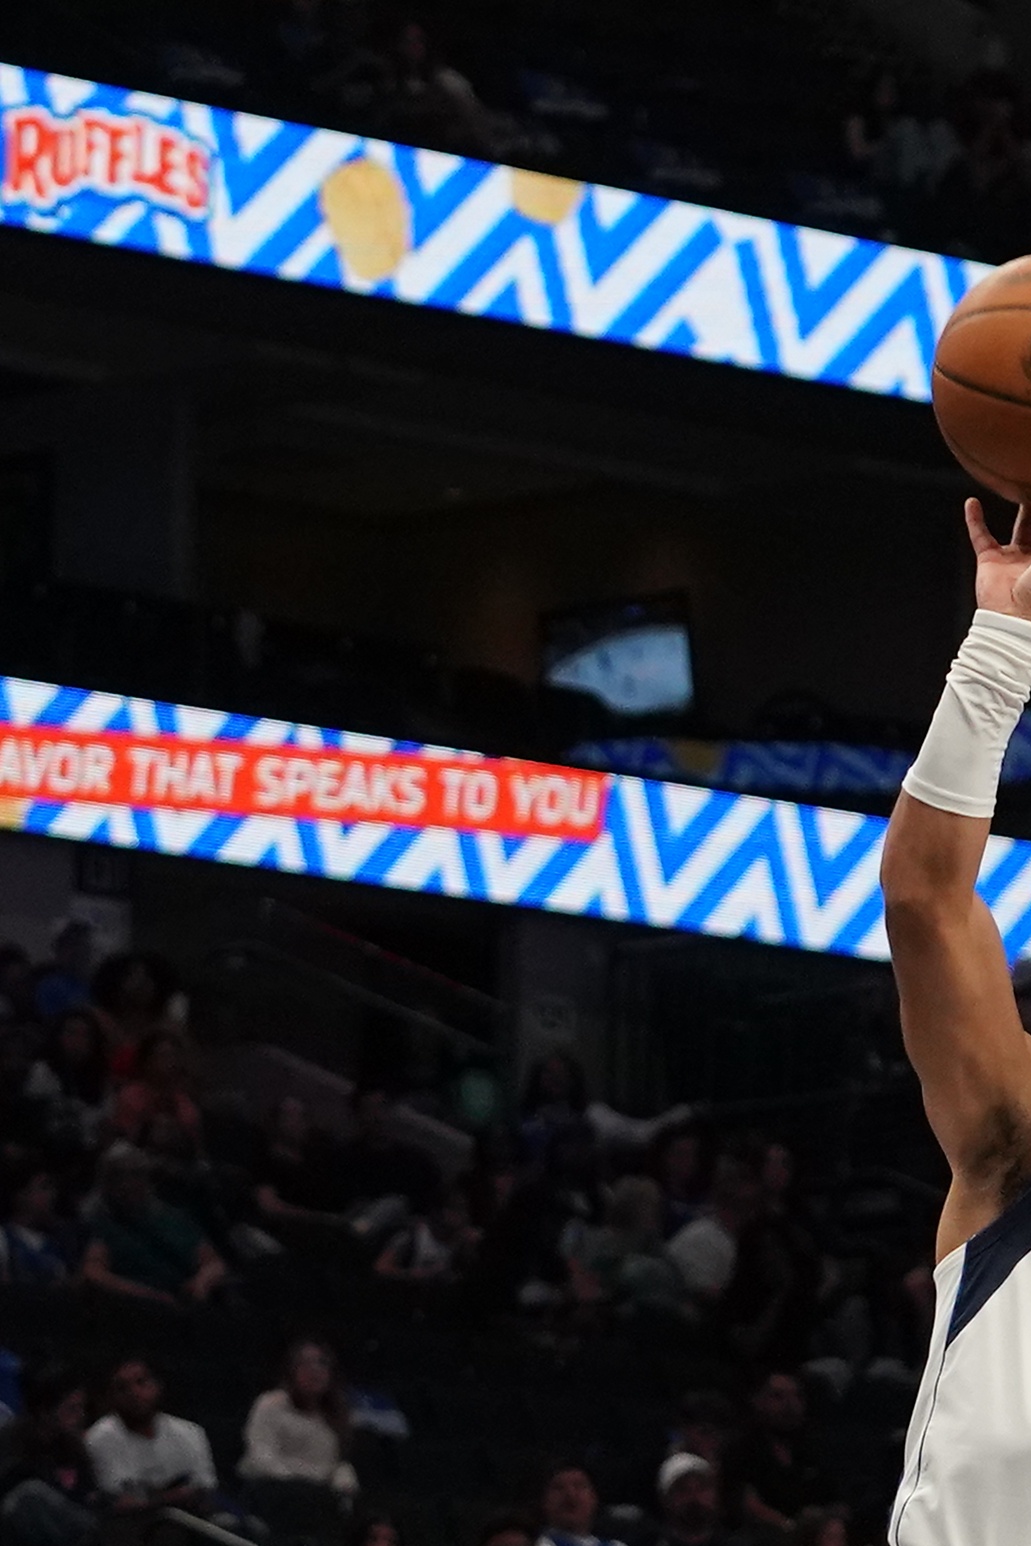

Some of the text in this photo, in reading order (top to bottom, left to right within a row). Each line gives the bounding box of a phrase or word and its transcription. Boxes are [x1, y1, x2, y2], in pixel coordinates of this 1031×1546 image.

[5, 112, 210, 210] RUFFLES
[127, 746, 243, 805] THAT
[254, 753, 427, 818] SPEAKS
[438, 767, 498, 822] TO
[508, 774, 598, 828] YOU
